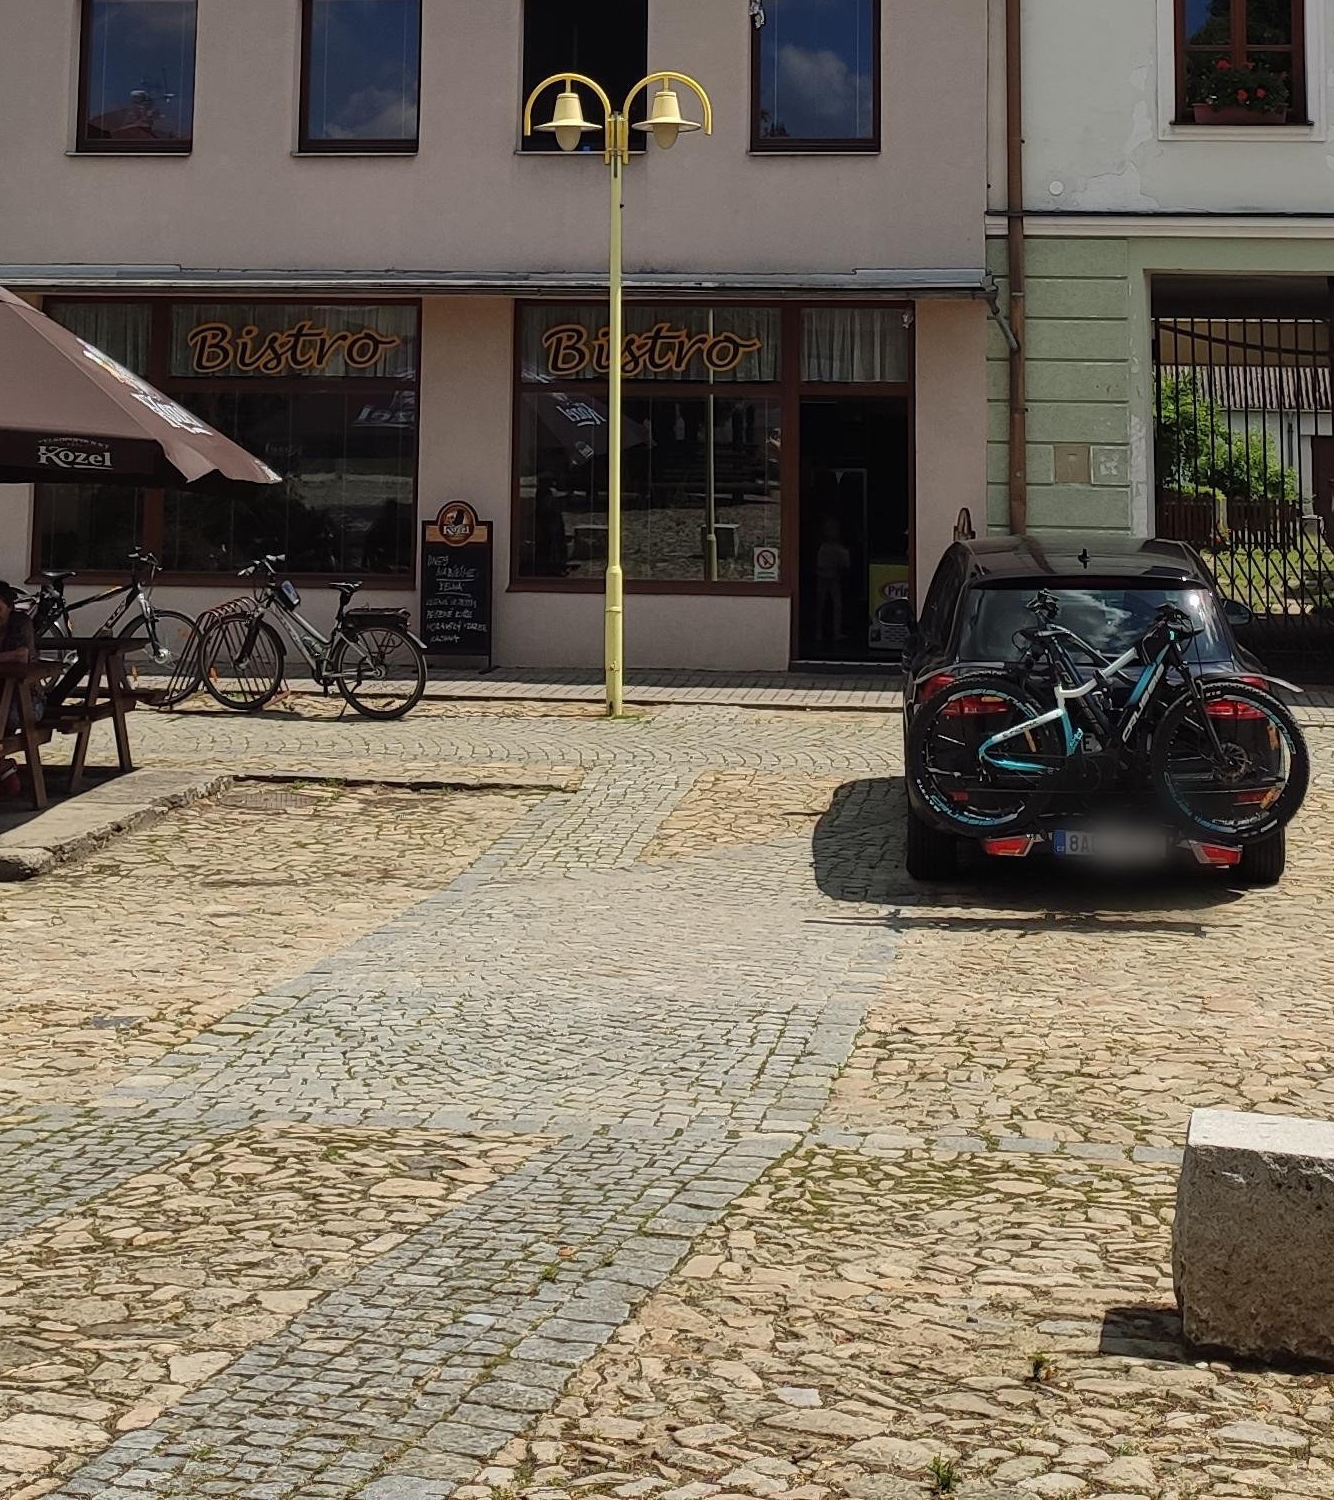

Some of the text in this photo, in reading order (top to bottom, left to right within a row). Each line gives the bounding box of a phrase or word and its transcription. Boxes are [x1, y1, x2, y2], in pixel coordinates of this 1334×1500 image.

[187, 320, 399, 375] Bistro
[542, 322, 762, 377] Bistro
[36, 445, 114, 470] Kozel
[443, 525, 471, 536] Kozel
